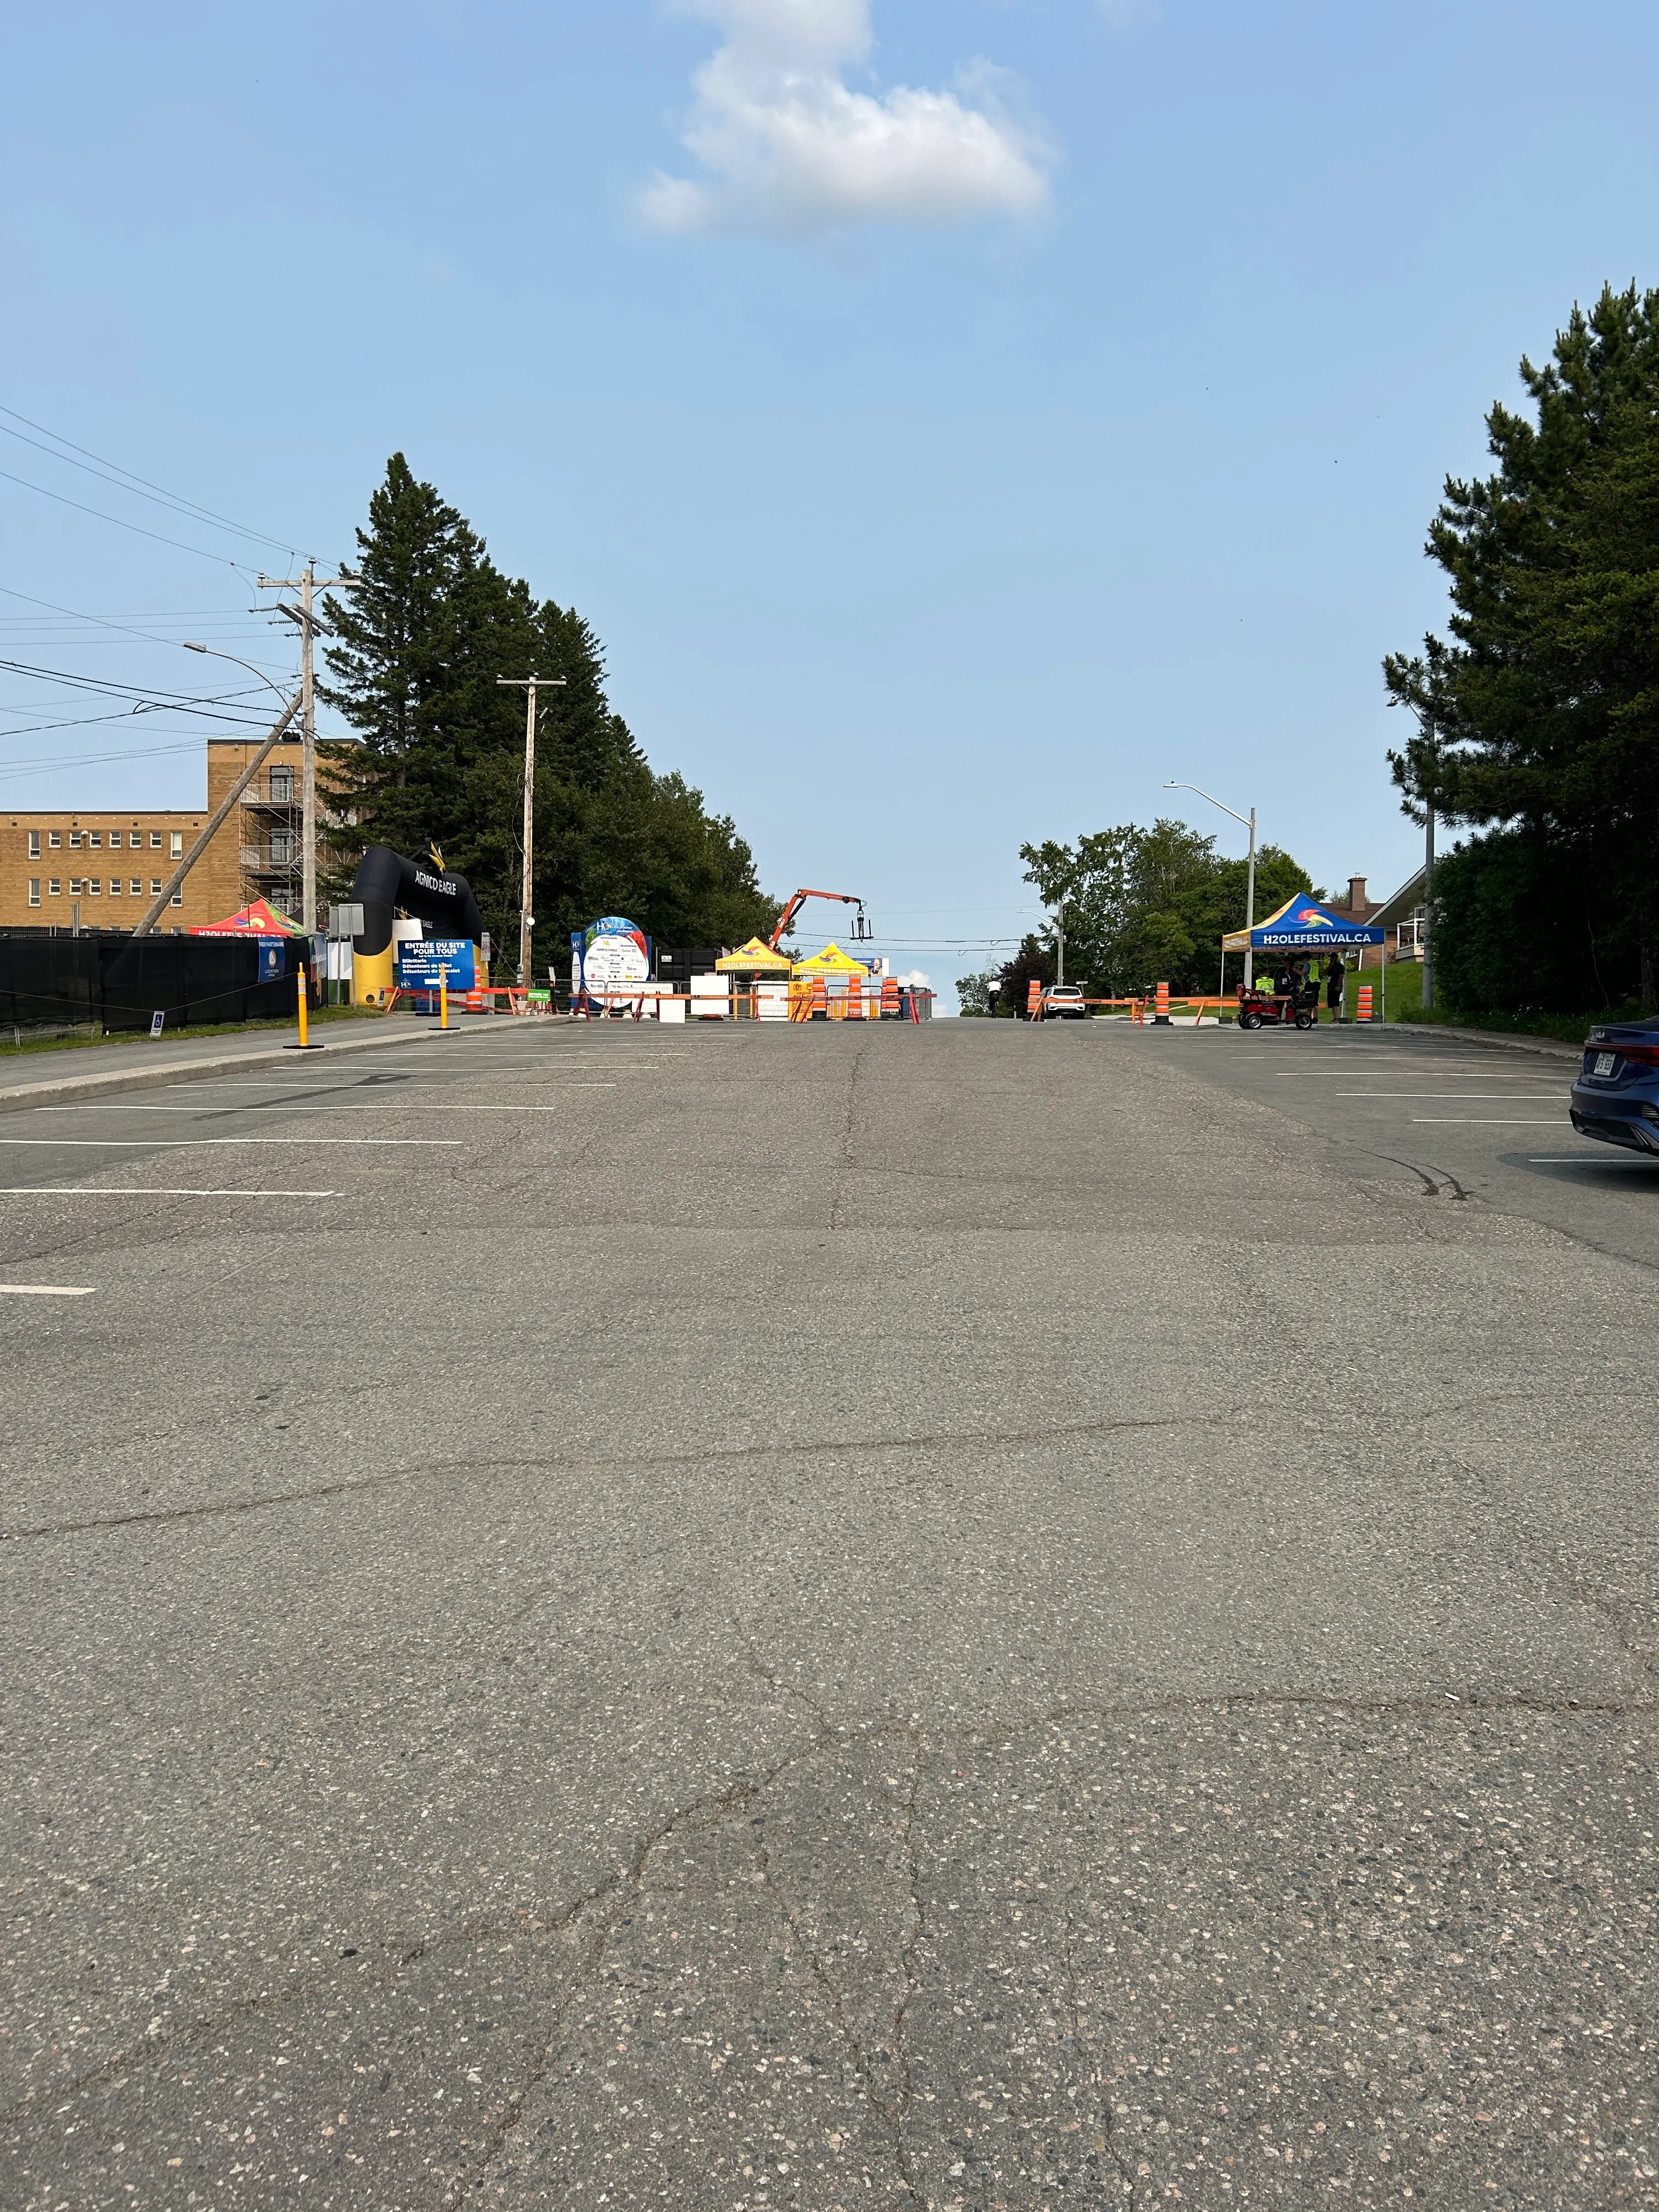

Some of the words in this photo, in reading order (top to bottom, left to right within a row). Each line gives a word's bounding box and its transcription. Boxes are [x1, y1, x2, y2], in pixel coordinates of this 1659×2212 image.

[415, 870, 438, 891] AGNICO
[438, 879, 457, 896] EAGLE
[405, 941, 435, 949] ENTRÉE
[1263, 933, 1372, 945] H2OLEFESTIVAL.CA
